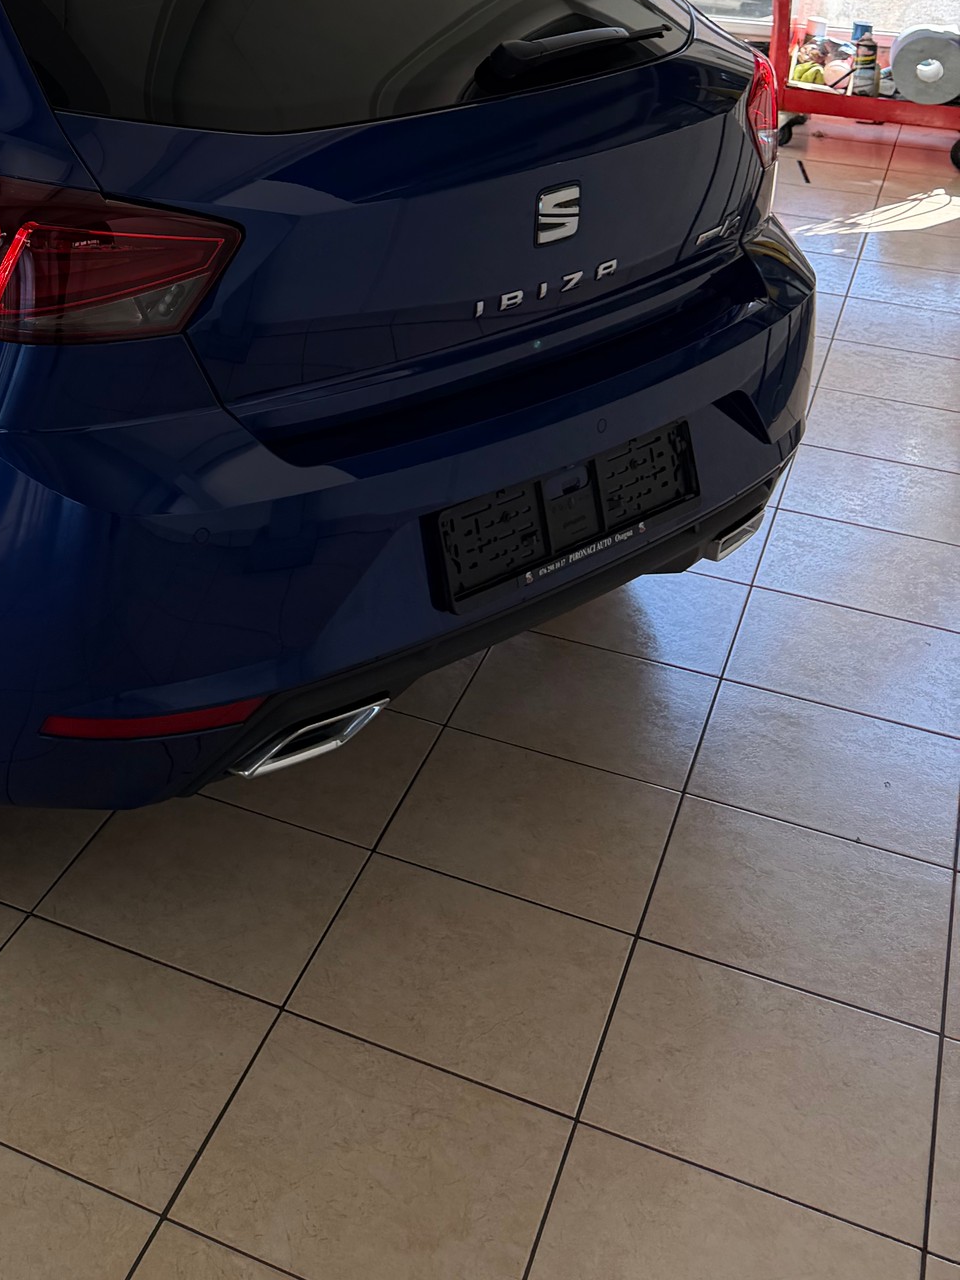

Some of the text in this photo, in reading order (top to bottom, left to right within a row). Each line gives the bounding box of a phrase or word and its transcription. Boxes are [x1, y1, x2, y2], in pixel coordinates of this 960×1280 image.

[473, 258, 619, 318] IBIZA
[568, 543, 596, 563] PIRONACI
[596, 537, 612, 550] AUTO
